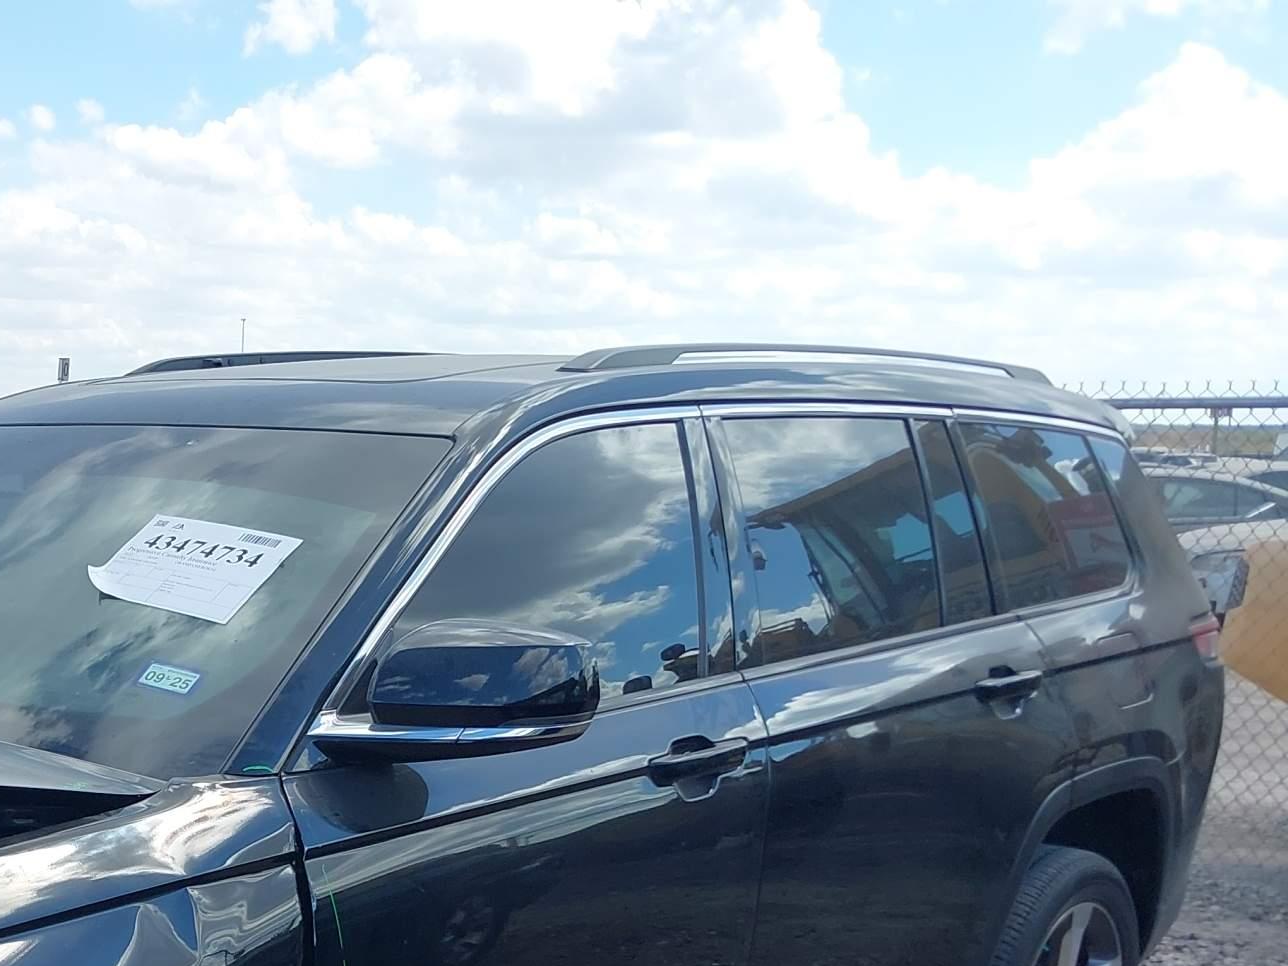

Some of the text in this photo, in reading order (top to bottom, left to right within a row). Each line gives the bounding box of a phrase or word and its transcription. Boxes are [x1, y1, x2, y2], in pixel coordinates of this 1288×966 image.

[143, 533, 265, 568] 43474734
[144, 670, 166, 683] 09
[169, 676, 193, 690] 25
